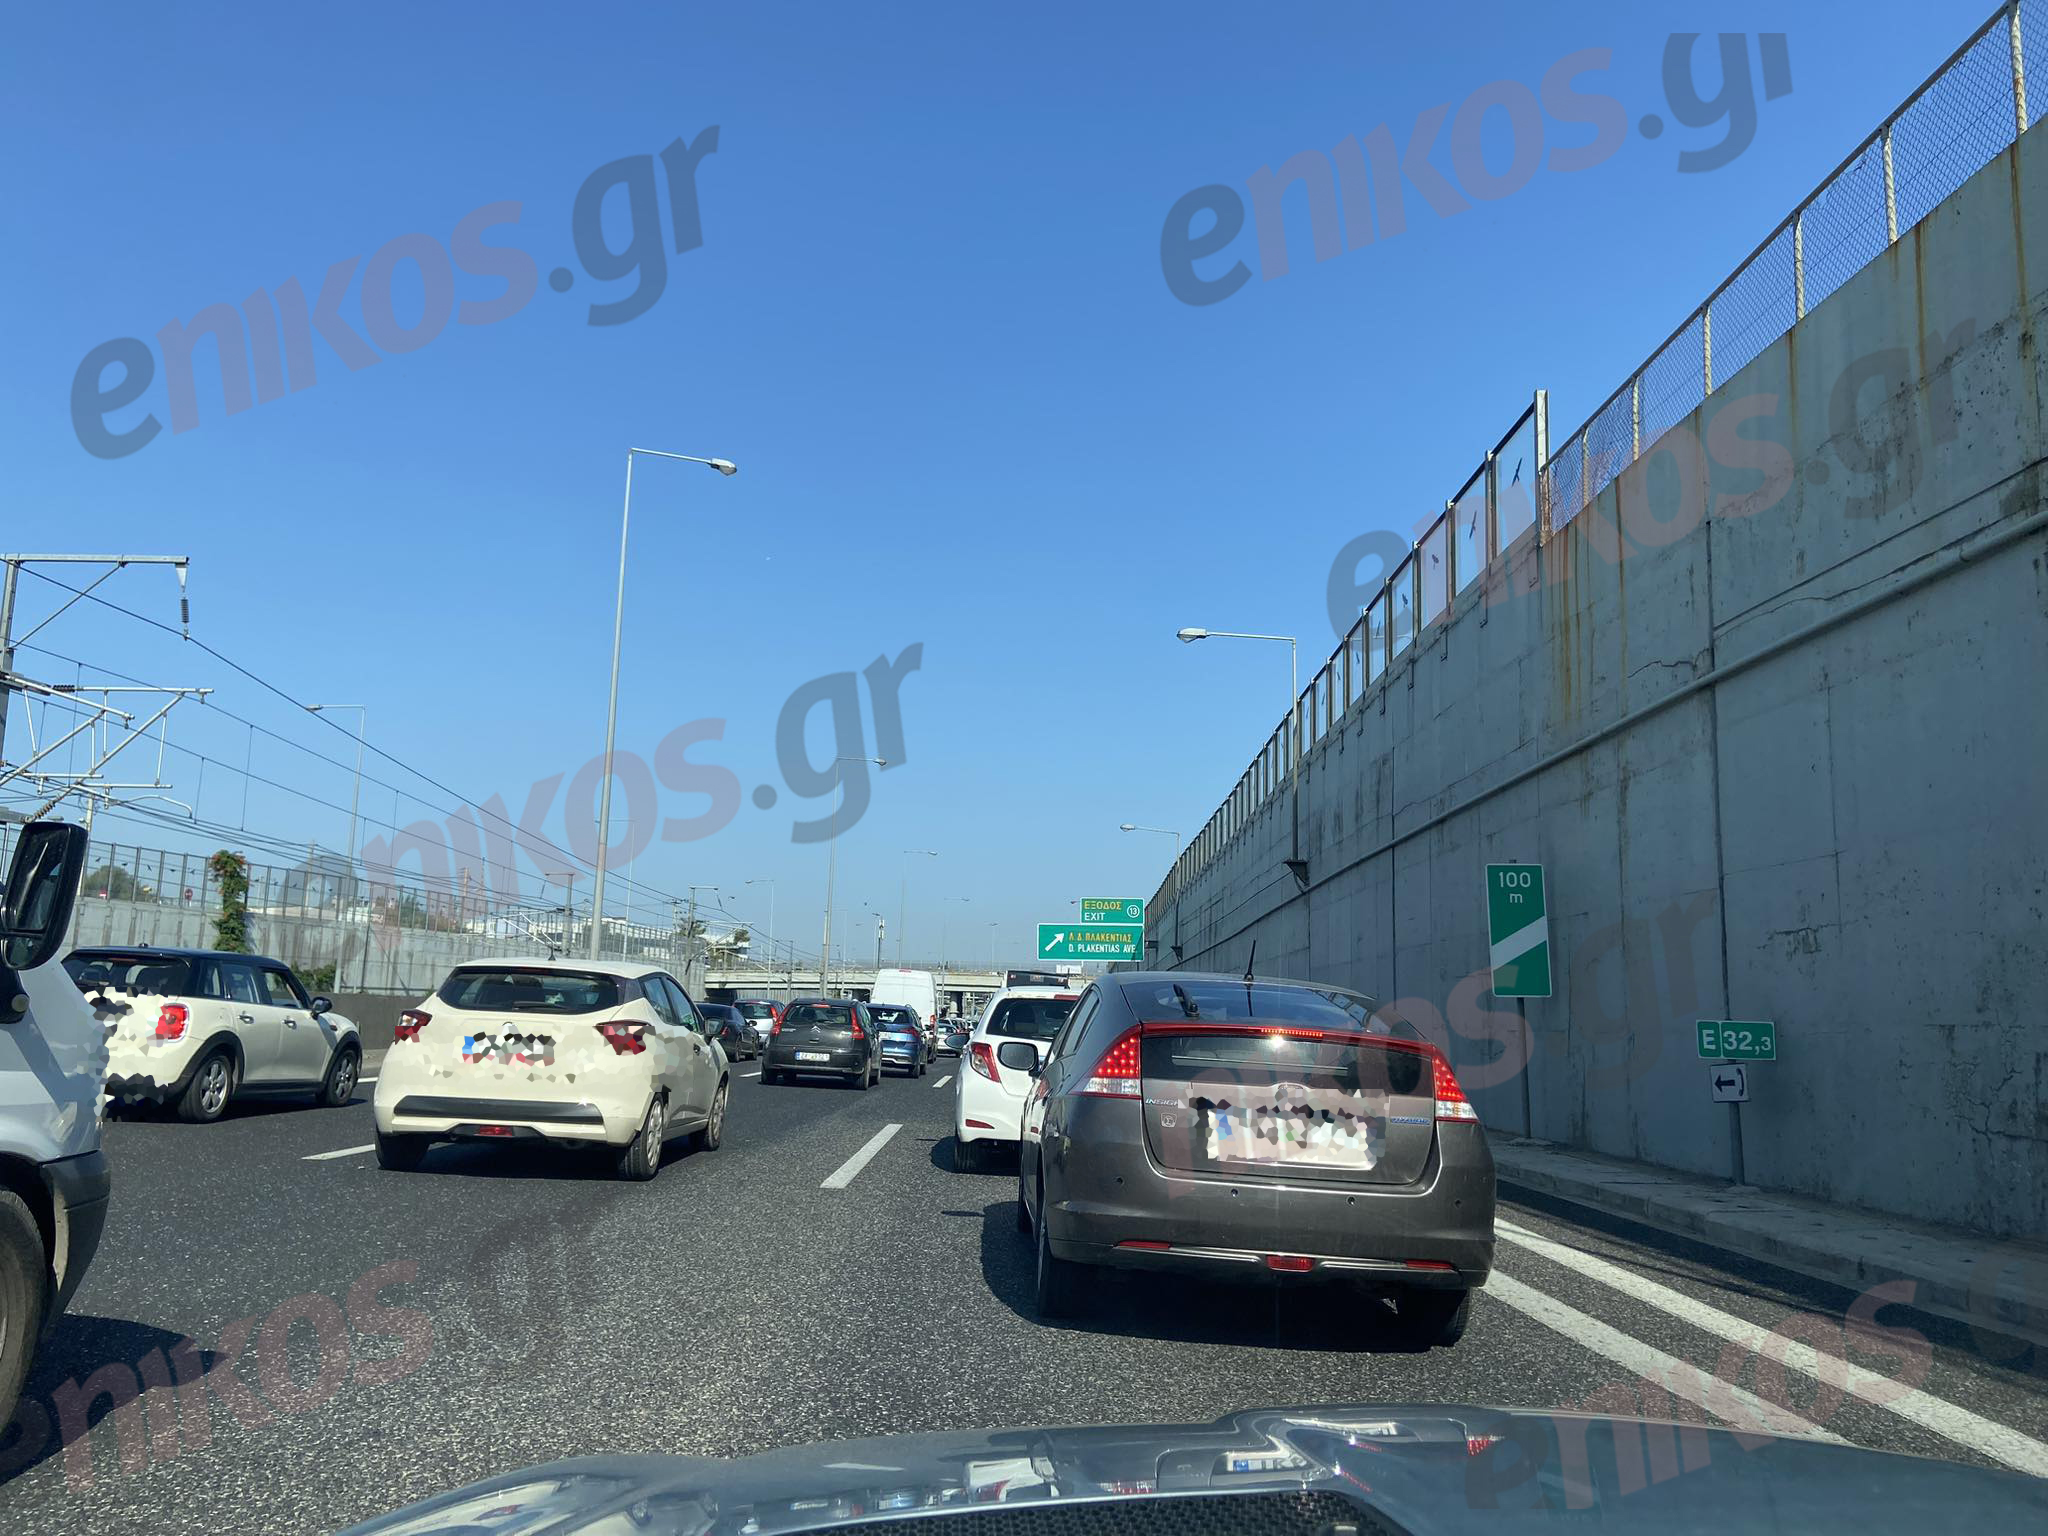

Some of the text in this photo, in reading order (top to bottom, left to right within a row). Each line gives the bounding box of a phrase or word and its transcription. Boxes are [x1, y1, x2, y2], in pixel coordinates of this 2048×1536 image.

[1499, 871, 1531, 888] 100
[1509, 893, 1523, 903] m
[1084, 900, 1122, 910] ΕΞΟΔΟΣ
[1129, 907, 1137, 915] 13
[1084, 912, 1106, 921] EXIT
[1085, 932, 1132, 943] ΠΛΑΚΕΝΤΙΑΣ
[1077, 943, 1120, 953] PLAKENTIAS
[1702, 1029, 1772, 1055] E 32,3
